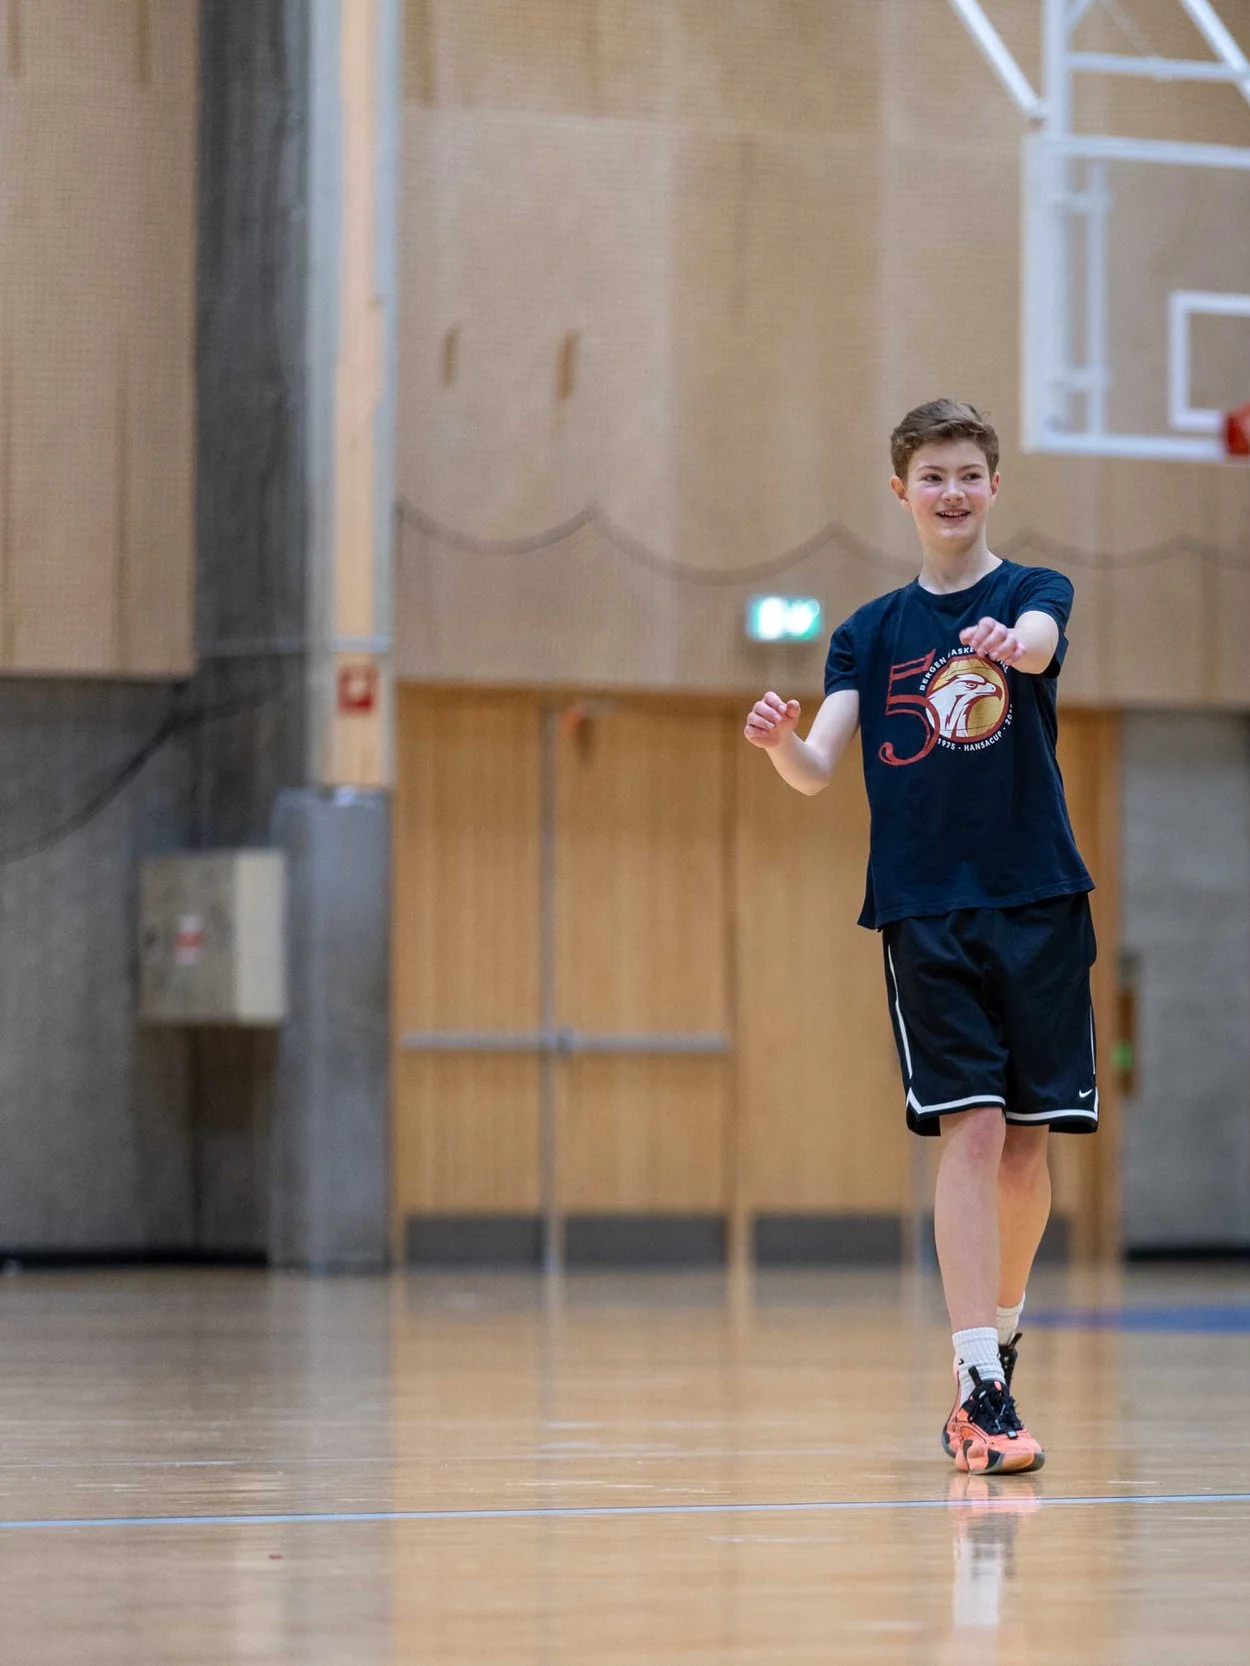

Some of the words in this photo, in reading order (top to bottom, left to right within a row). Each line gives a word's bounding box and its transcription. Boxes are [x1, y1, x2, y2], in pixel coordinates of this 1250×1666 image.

[919, 656, 948, 691] BERGEN
[937, 738, 956, 751] 1975
[963, 730, 1002, 752] HANSACUP
[1004, 703, 1013, 726] 20
